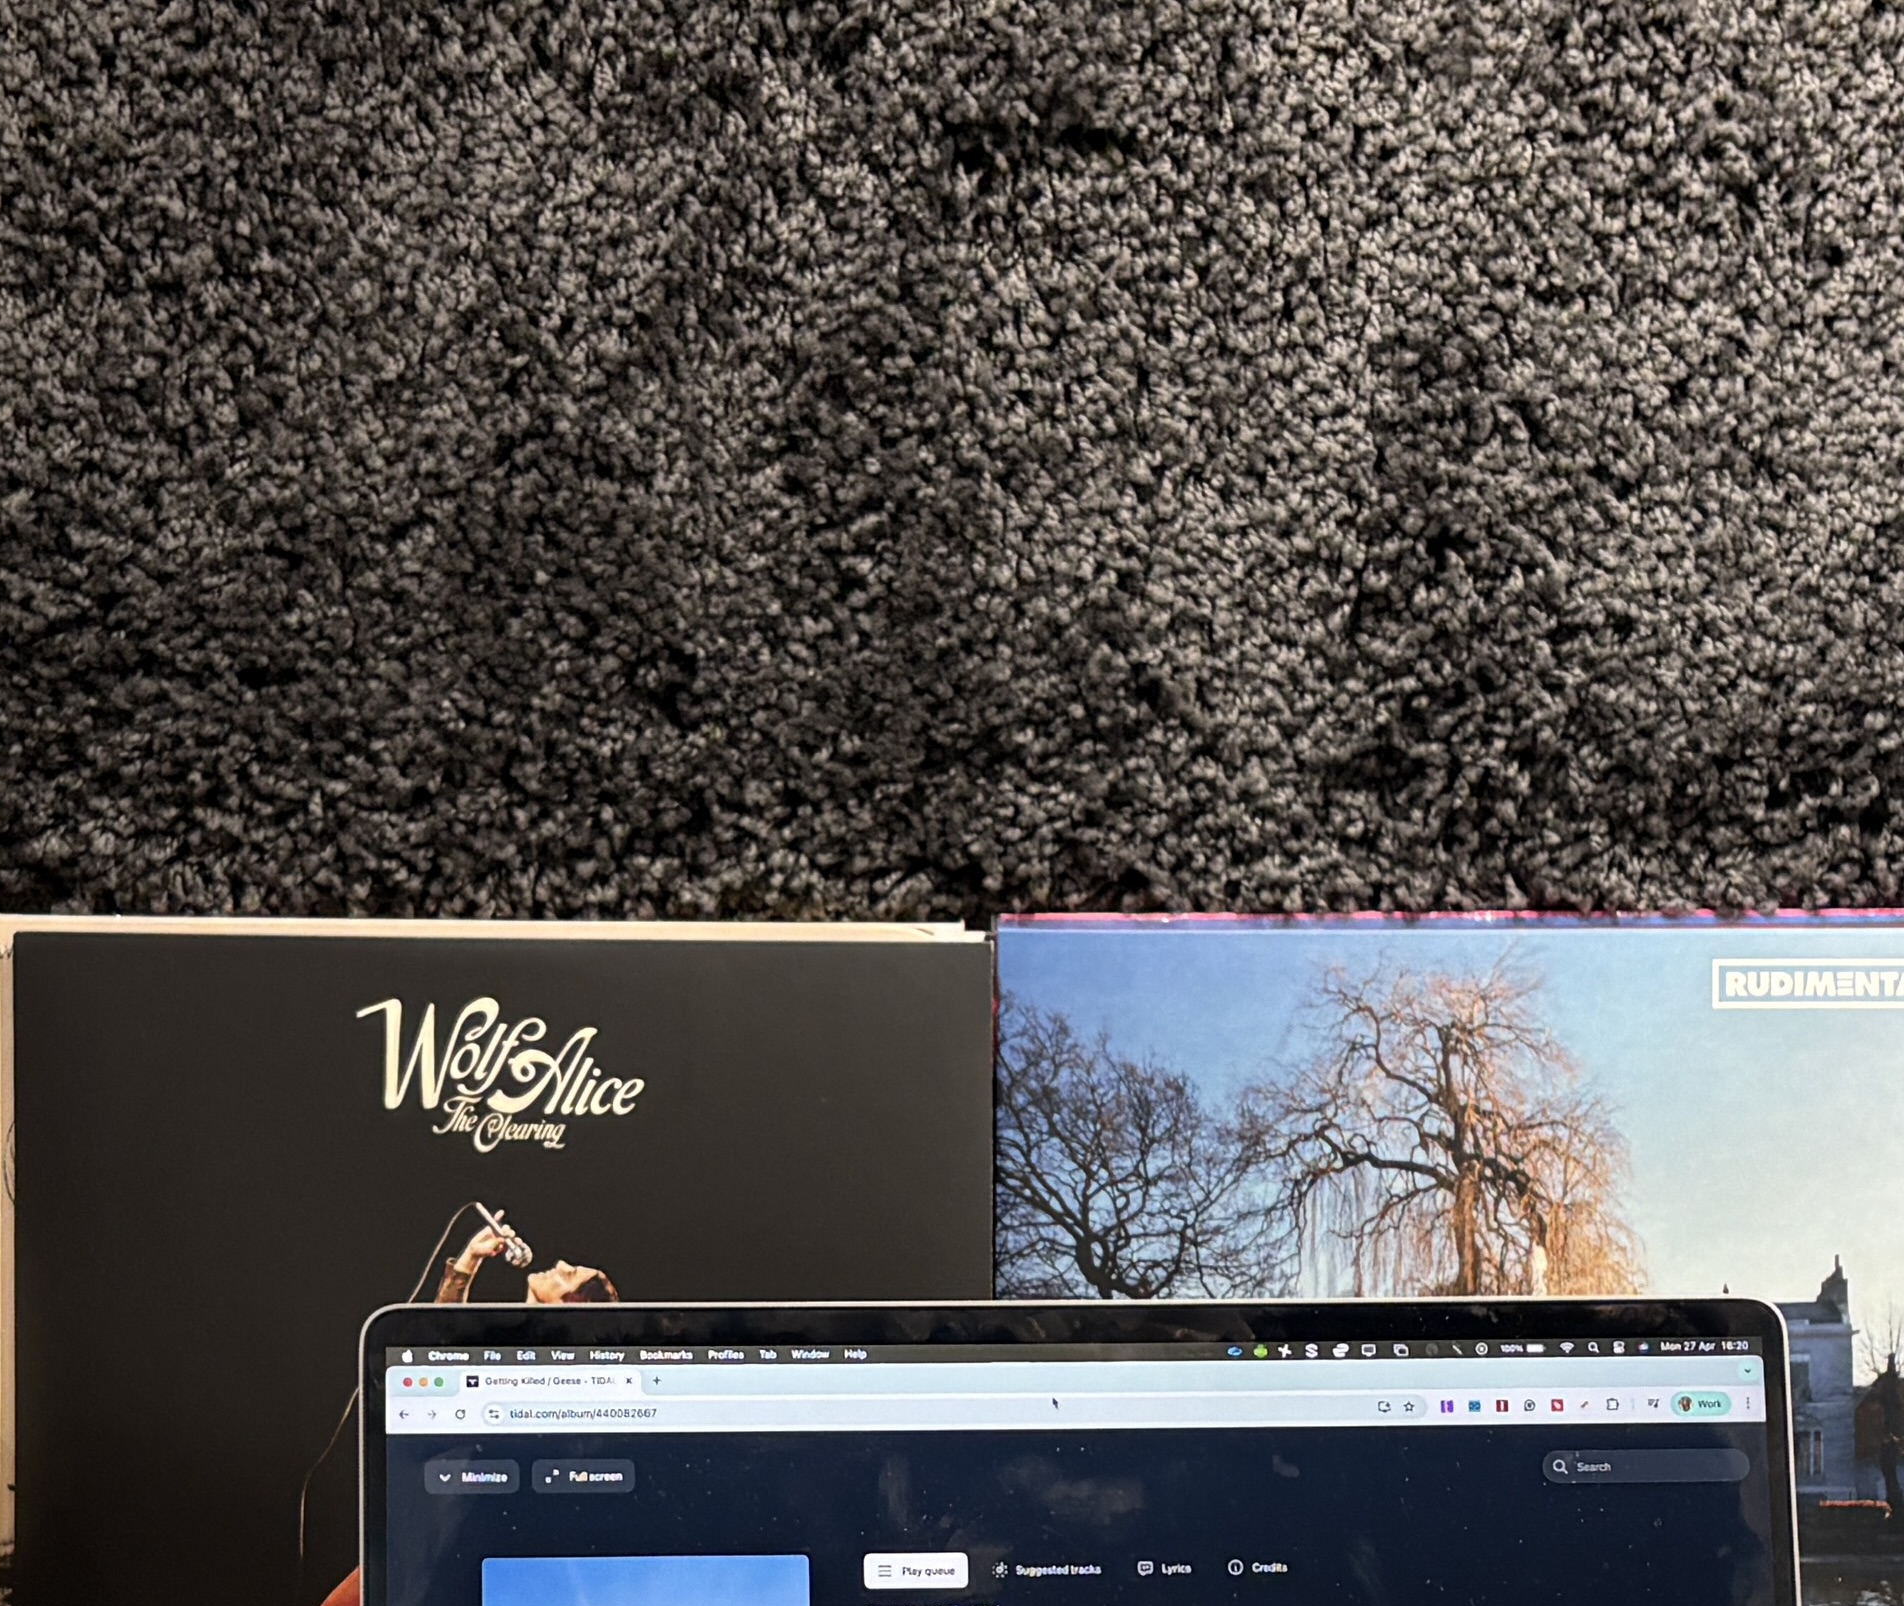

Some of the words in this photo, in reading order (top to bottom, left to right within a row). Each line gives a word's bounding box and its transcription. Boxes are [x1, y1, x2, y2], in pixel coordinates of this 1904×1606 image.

[356, 997, 547, 1110] Wolf
[487, 1026, 645, 1116] Alice
[432, 1096, 482, 1135] The
[473, 1112, 567, 1153] Clearing
[1661, 1342, 1680, 1351] Mon
[1684, 1341, 1696, 1351] 27
[1699, 1341, 1715, 1353] Apr
[428, 1350, 469, 1361] Chrome
[484, 1350, 501, 1360] File
[517, 1350, 535, 1360] Edit
[551, 1350, 574, 1360] View
[590, 1350, 625, 1362] History
[640, 1349, 693, 1360] Bookmarks
[708, 1349, 744, 1360] Profiles
[760, 1349, 776, 1359] Tab
[792, 1349, 829, 1359] Window
[844, 1349, 867, 1361] Help
[1698, 1399, 1721, 1409] Work
[1577, 1461, 1611, 1472] Search
[462, 1471, 508, 1483] Minimize
[569, 1472, 587, 1483] Full
[588, 1474, 623, 1483] screen
[902, 1566, 922, 1578] Play
[925, 1568, 955, 1578] queue
[1016, 1565, 1068, 1577] Suggested
[1071, 1565, 1101, 1575] tracks
[1161, 1563, 1192, 1576] Lyrics
[1252, 1562, 1288, 1573] Credits
